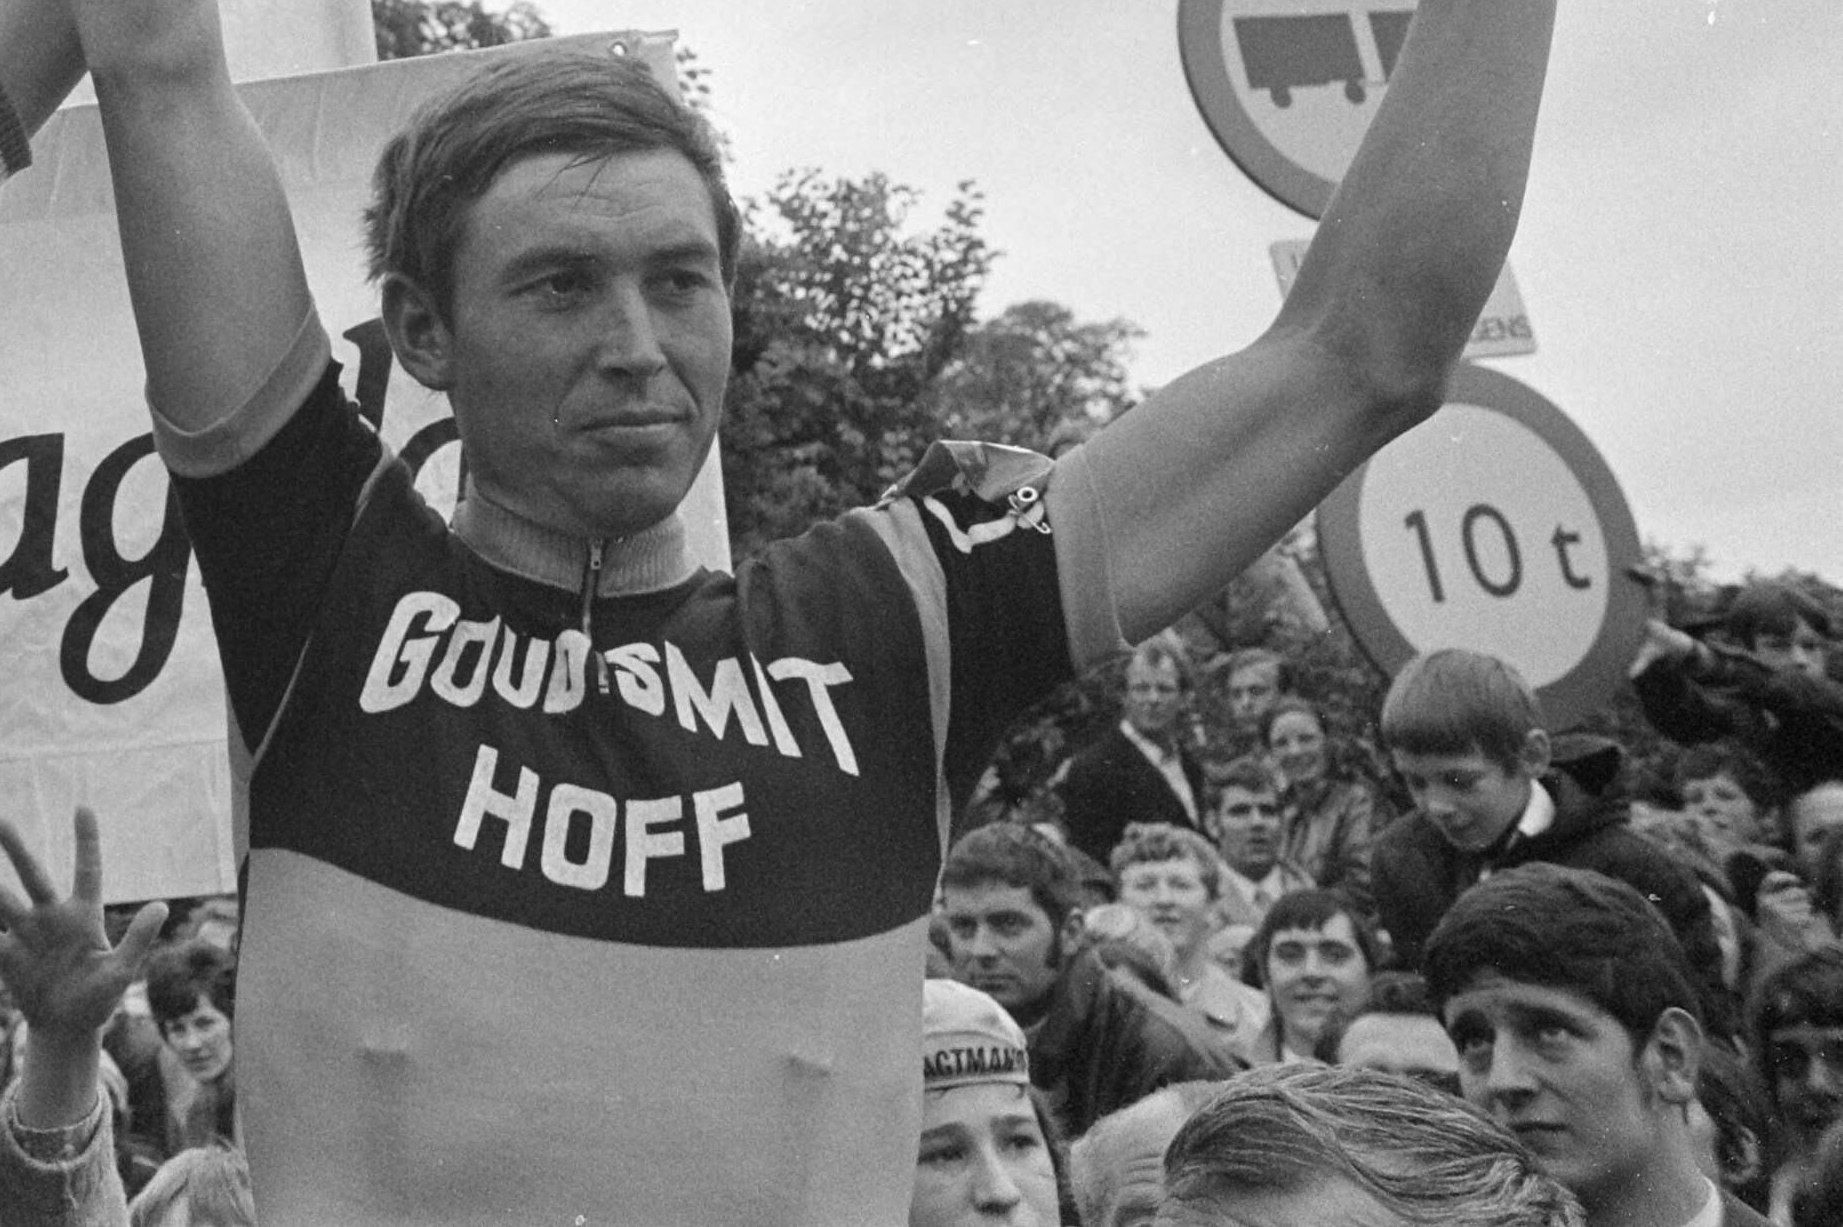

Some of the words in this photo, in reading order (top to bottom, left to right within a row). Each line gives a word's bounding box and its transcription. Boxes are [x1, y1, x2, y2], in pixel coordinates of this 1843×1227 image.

[1404, 503, 1523, 604] 10
[1550, 524, 1592, 590] t
[454, 744, 751, 896] HOFF
